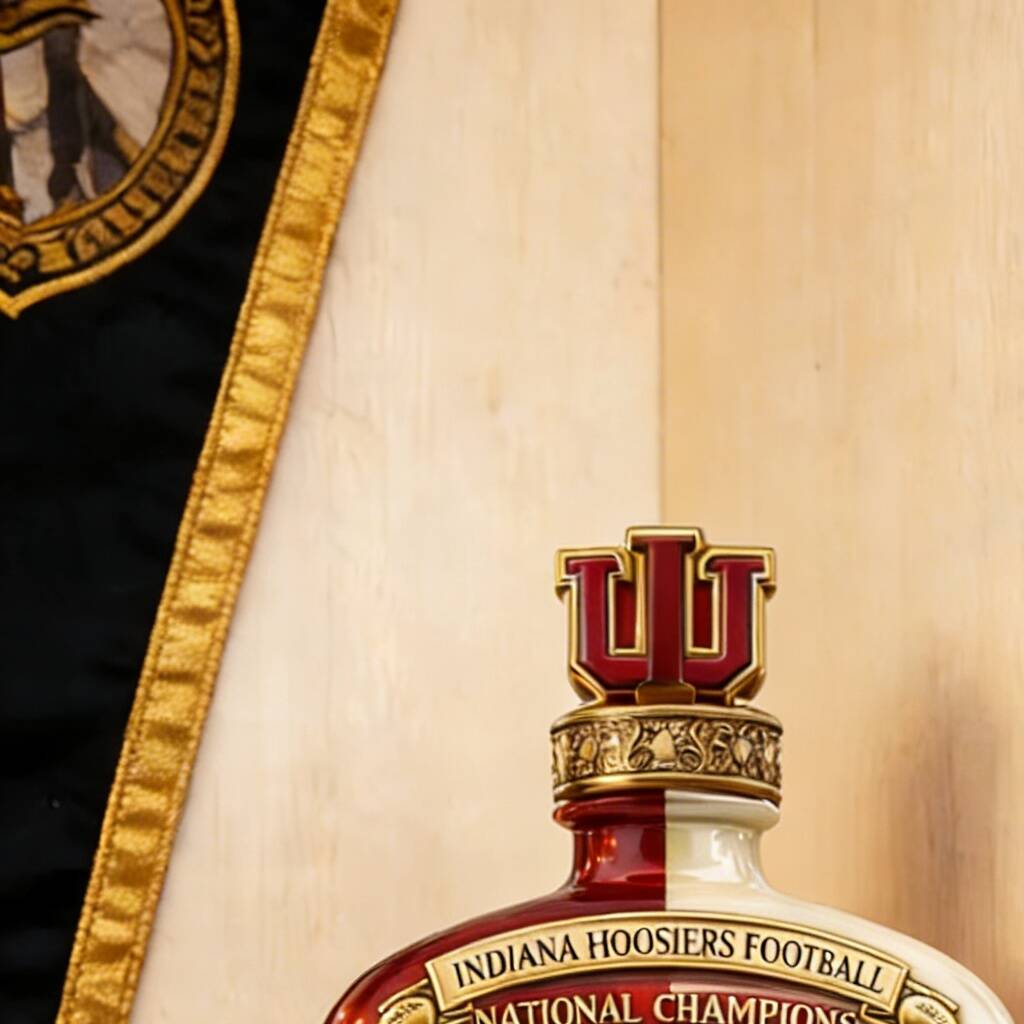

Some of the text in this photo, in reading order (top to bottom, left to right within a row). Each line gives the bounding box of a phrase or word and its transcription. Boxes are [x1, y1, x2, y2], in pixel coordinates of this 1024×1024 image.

[453, 926, 884, 994] INDIANA HOOSIERS FOOTBALL
